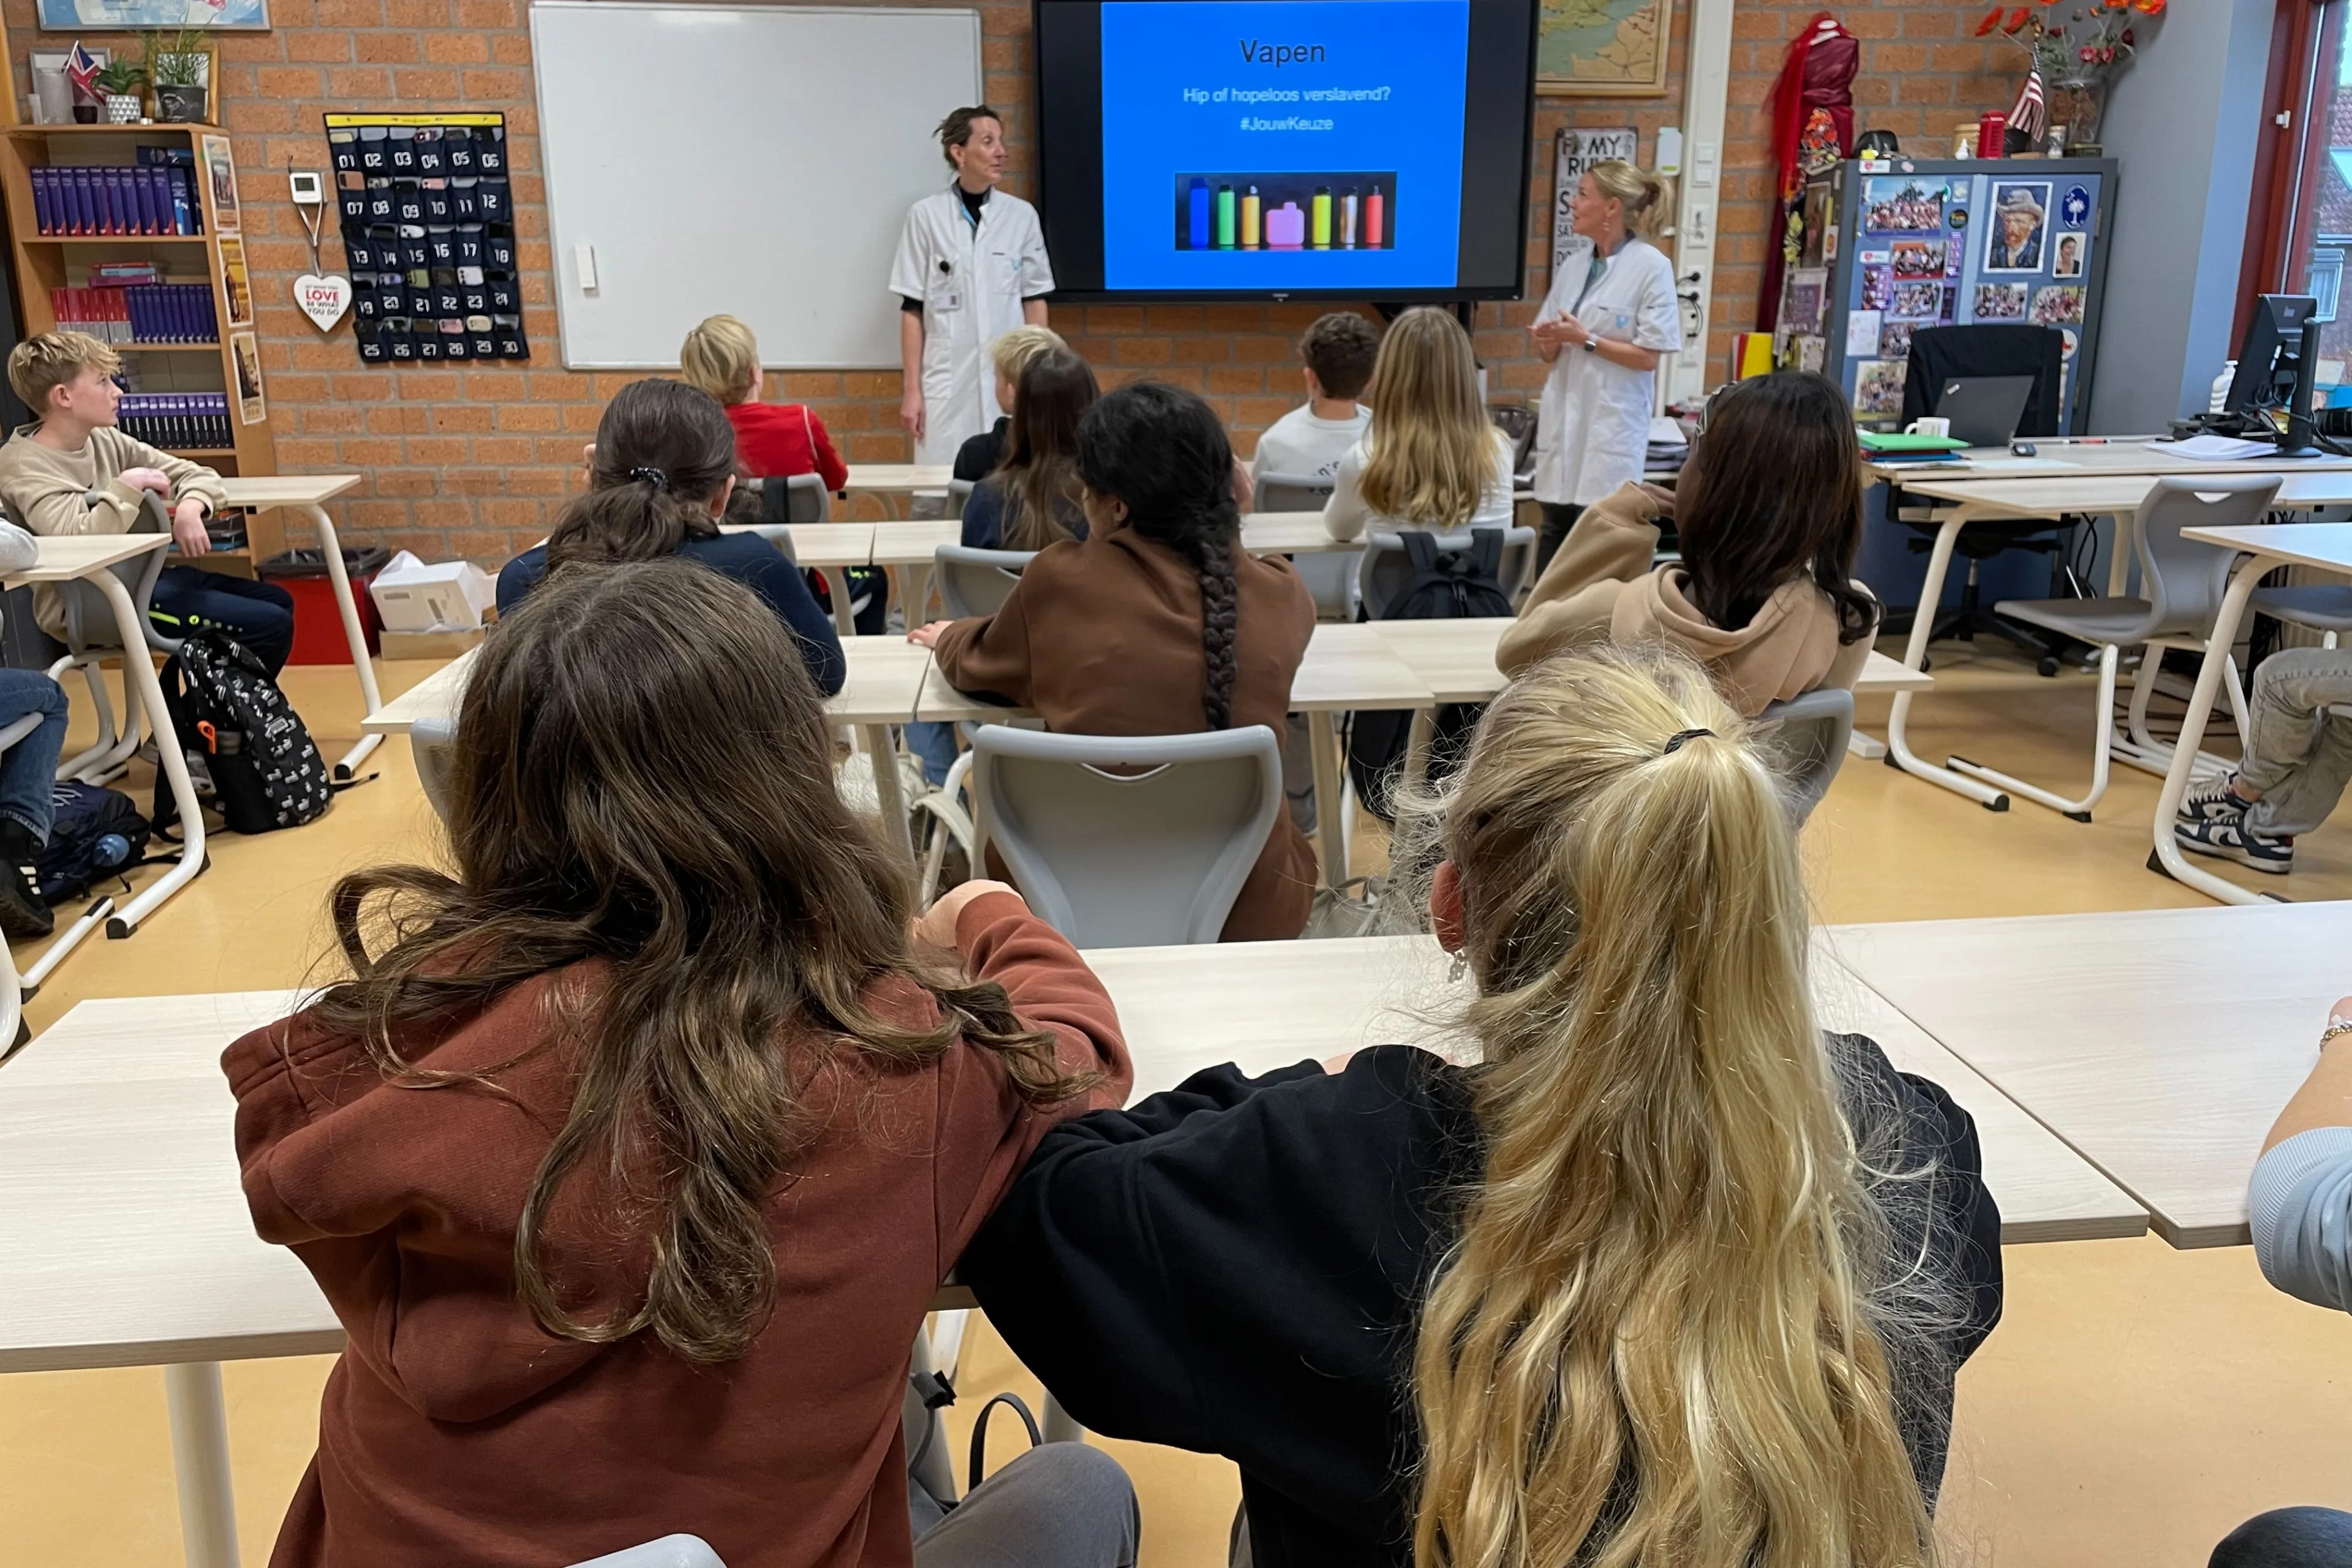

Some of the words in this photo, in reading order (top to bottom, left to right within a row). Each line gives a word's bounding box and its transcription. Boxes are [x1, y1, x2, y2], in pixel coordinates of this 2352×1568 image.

[1240, 39, 1325, 68] Vapen
[1183, 88, 1209, 105] Hip
[1212, 87, 1228, 102] of
[1231, 88, 1300, 105] hopeloos
[1303, 86, 1392, 102] verslavend?
[1240, 116, 1335, 131] #JouwKeuze
[339, 155, 355, 168] 01
[365, 153, 382, 167] 02
[394, 152, 412, 165] 03
[421, 154, 439, 168] 04
[453, 151, 469, 165] 05
[482, 154, 499, 167] 06
[459, 200, 472, 213] 11
[483, 194, 497, 208] 12
[347, 202, 363, 214] 07
[402, 205, 419, 218] 09
[431, 202, 445, 214] 10
[409, 250, 424, 262] 15
[434, 244, 450, 257] 16
[463, 243, 477, 257] 17
[495, 249, 508, 263] 18
[354, 251, 368, 263] 13
[383, 252, 396, 265] 14
[359, 301, 373, 314] 19
[416, 298, 429, 312] 21
[442, 296, 457, 309] 22
[423, 344, 436, 356] 27
